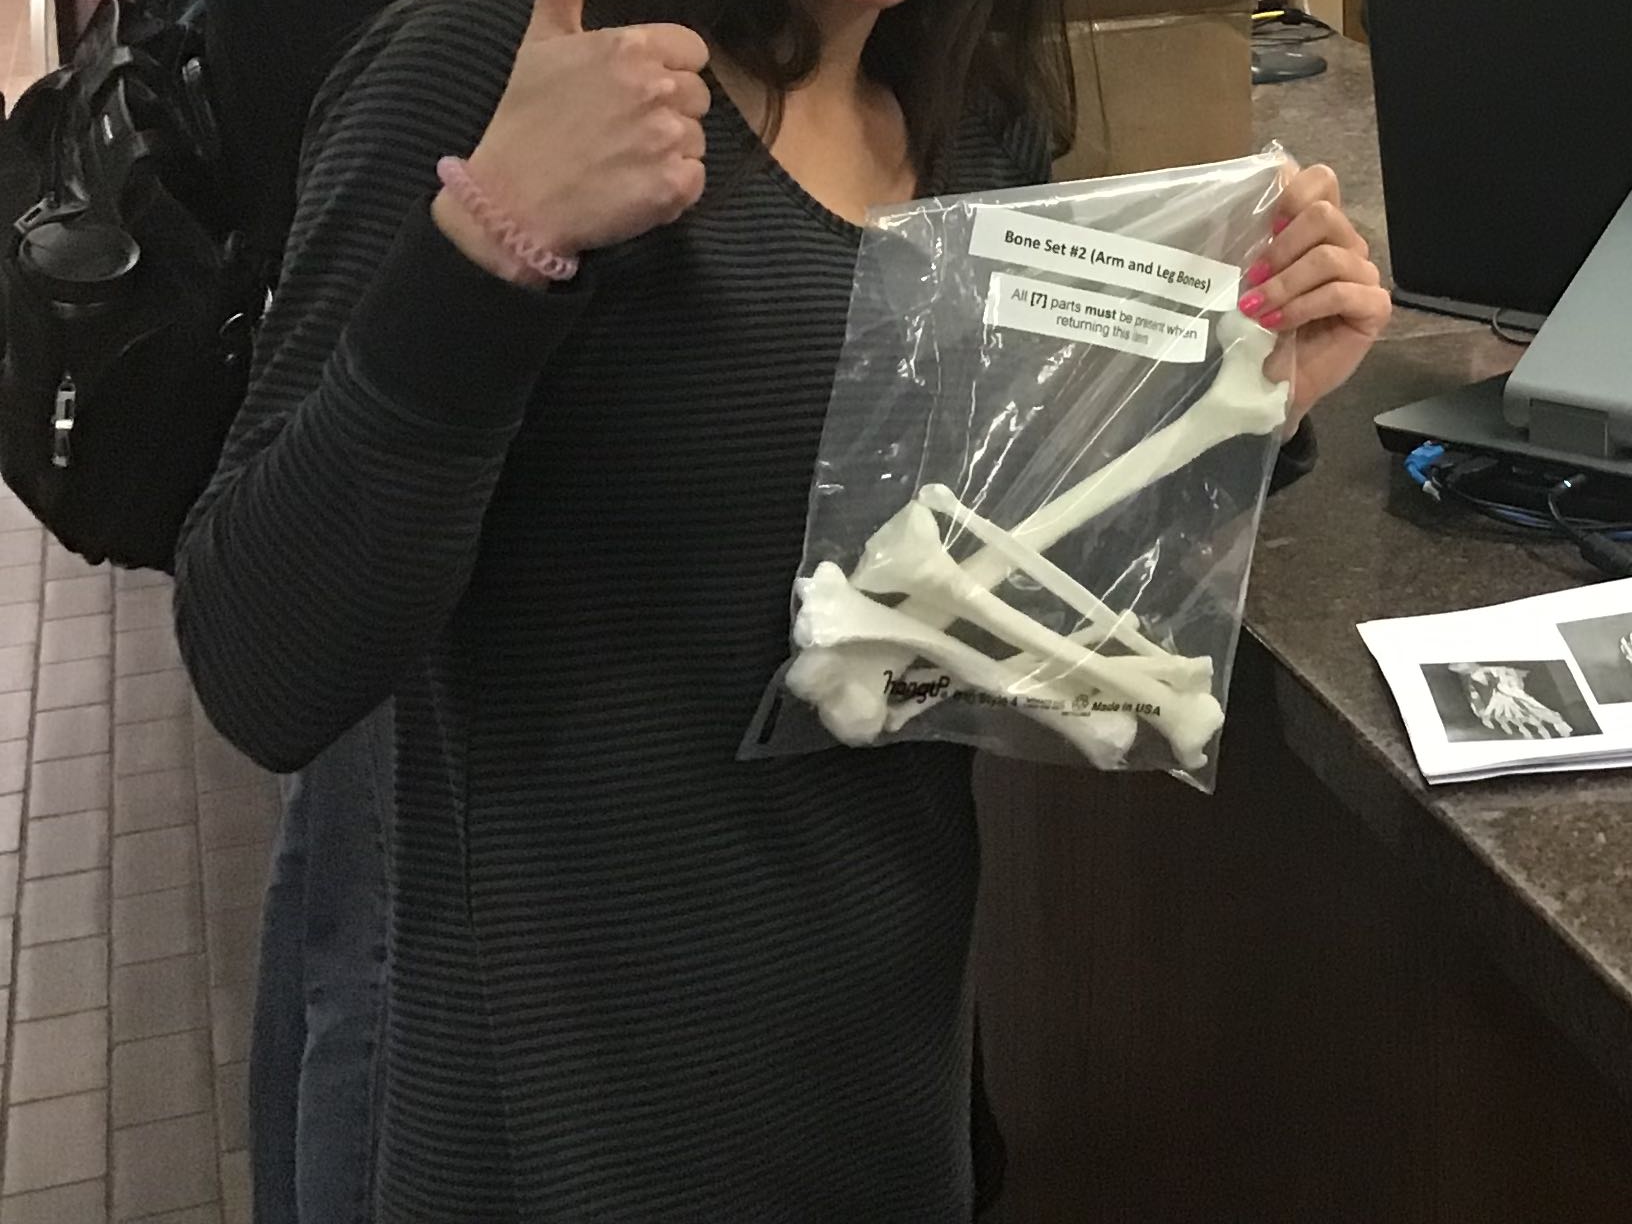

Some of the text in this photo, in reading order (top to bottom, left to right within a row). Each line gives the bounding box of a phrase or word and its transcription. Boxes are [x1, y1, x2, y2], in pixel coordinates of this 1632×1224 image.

[1004, 230, 1211, 294] Bone Set #2 (Arm and Leg Bones)
[1011, 288, 1028, 302] All
[1030, 292, 1048, 308] [7]
[1050, 298, 1082, 313] parts
[1085, 305, 1117, 320] must
[1119, 309, 1133, 324] be
[1056, 314, 1110, 338] returning
[1112, 325, 1130, 341] this
[1091, 700, 1121, 713] Made
[1136, 702, 1161, 716] USA
